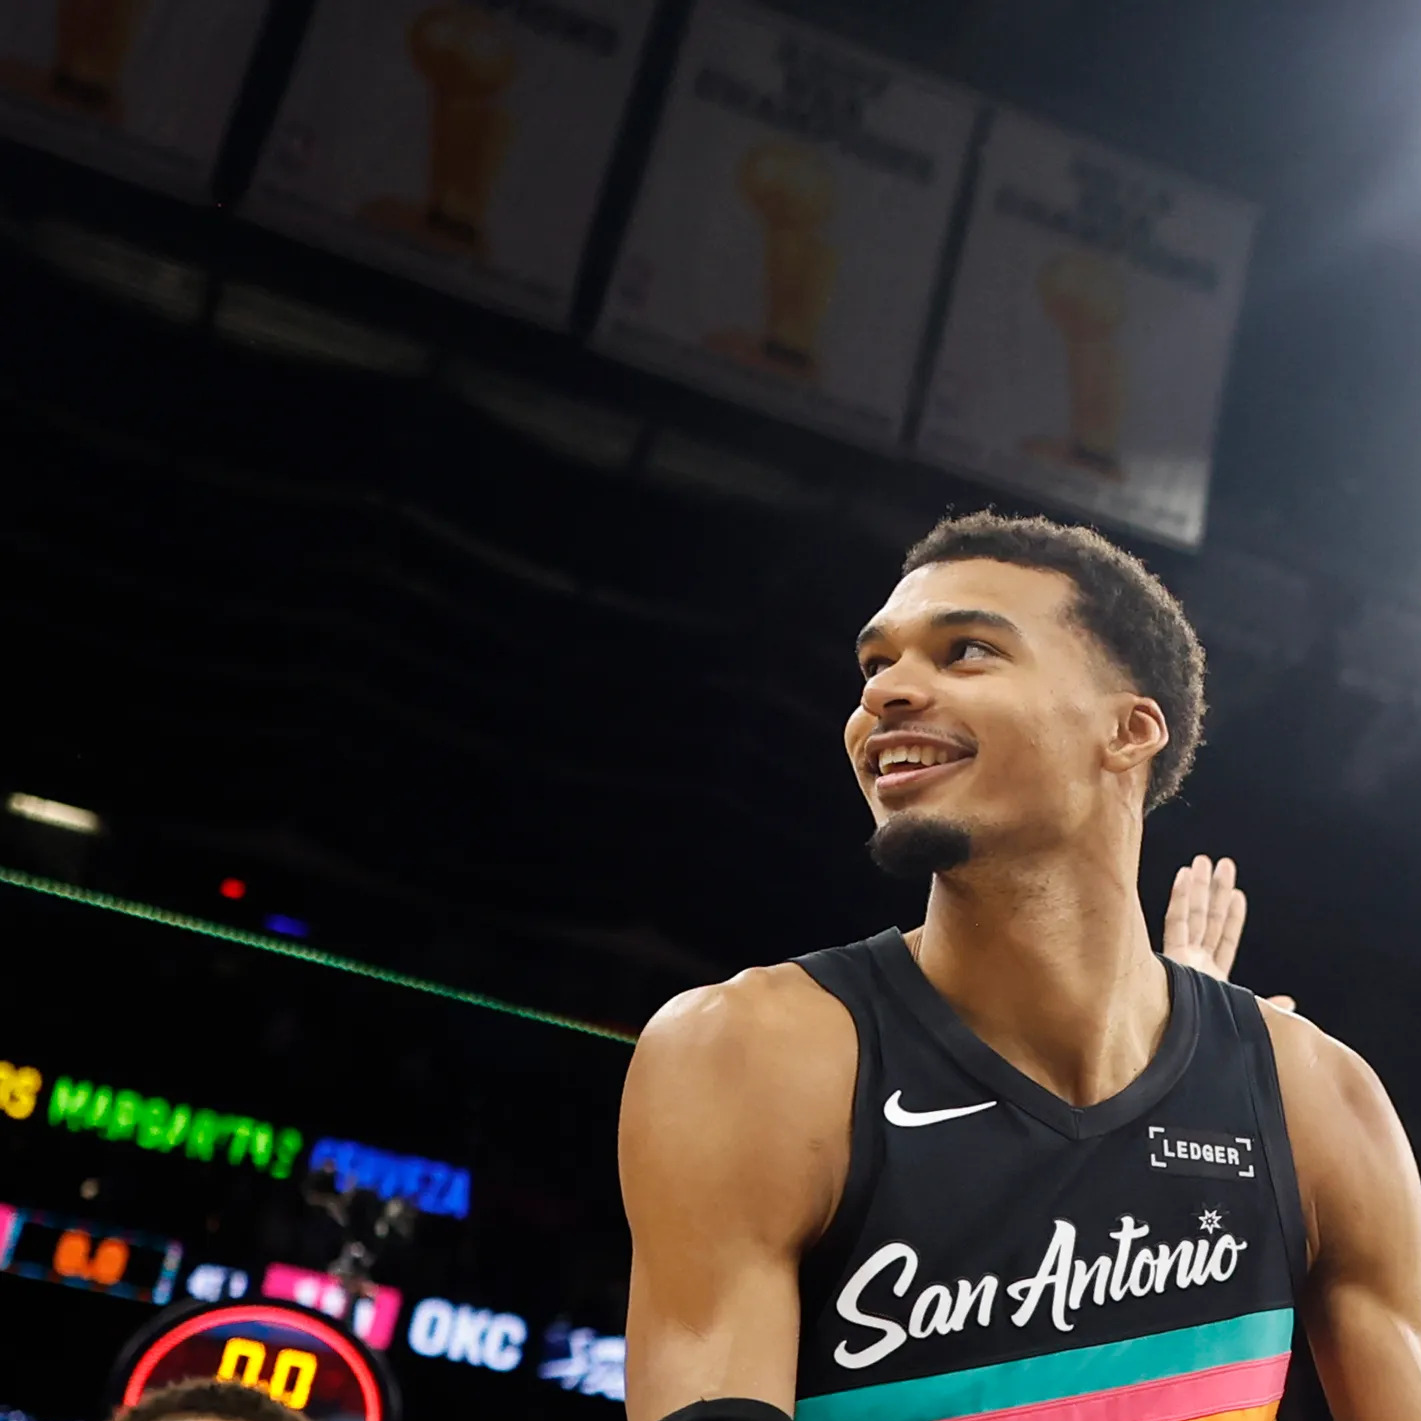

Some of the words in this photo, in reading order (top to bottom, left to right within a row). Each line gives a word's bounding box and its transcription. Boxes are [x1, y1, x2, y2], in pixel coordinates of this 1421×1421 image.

[1162, 1138, 1241, 1166] LEDGER
[833, 1242, 998, 1369] San
[1007, 1208, 1248, 1332] Antonio
[408, 1297, 528, 1372] OKC
